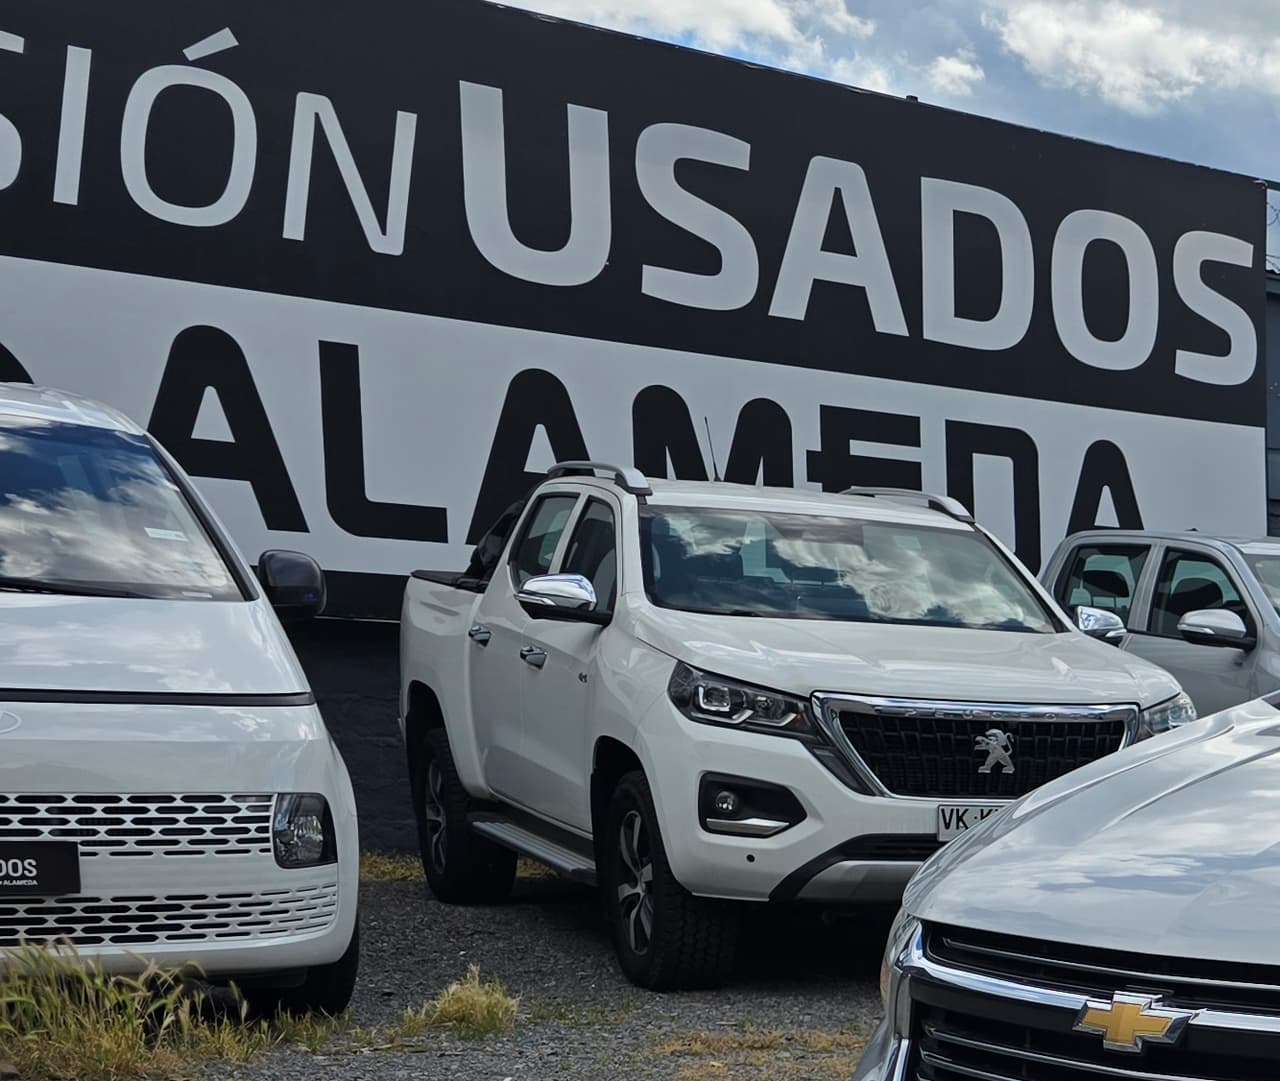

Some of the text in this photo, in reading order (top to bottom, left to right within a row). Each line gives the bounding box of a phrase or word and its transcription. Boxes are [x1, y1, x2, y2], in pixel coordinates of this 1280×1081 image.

[0, 28, 1259, 387] IÓN USADOS
[904, 708, 1093, 722] PEUGEOT
